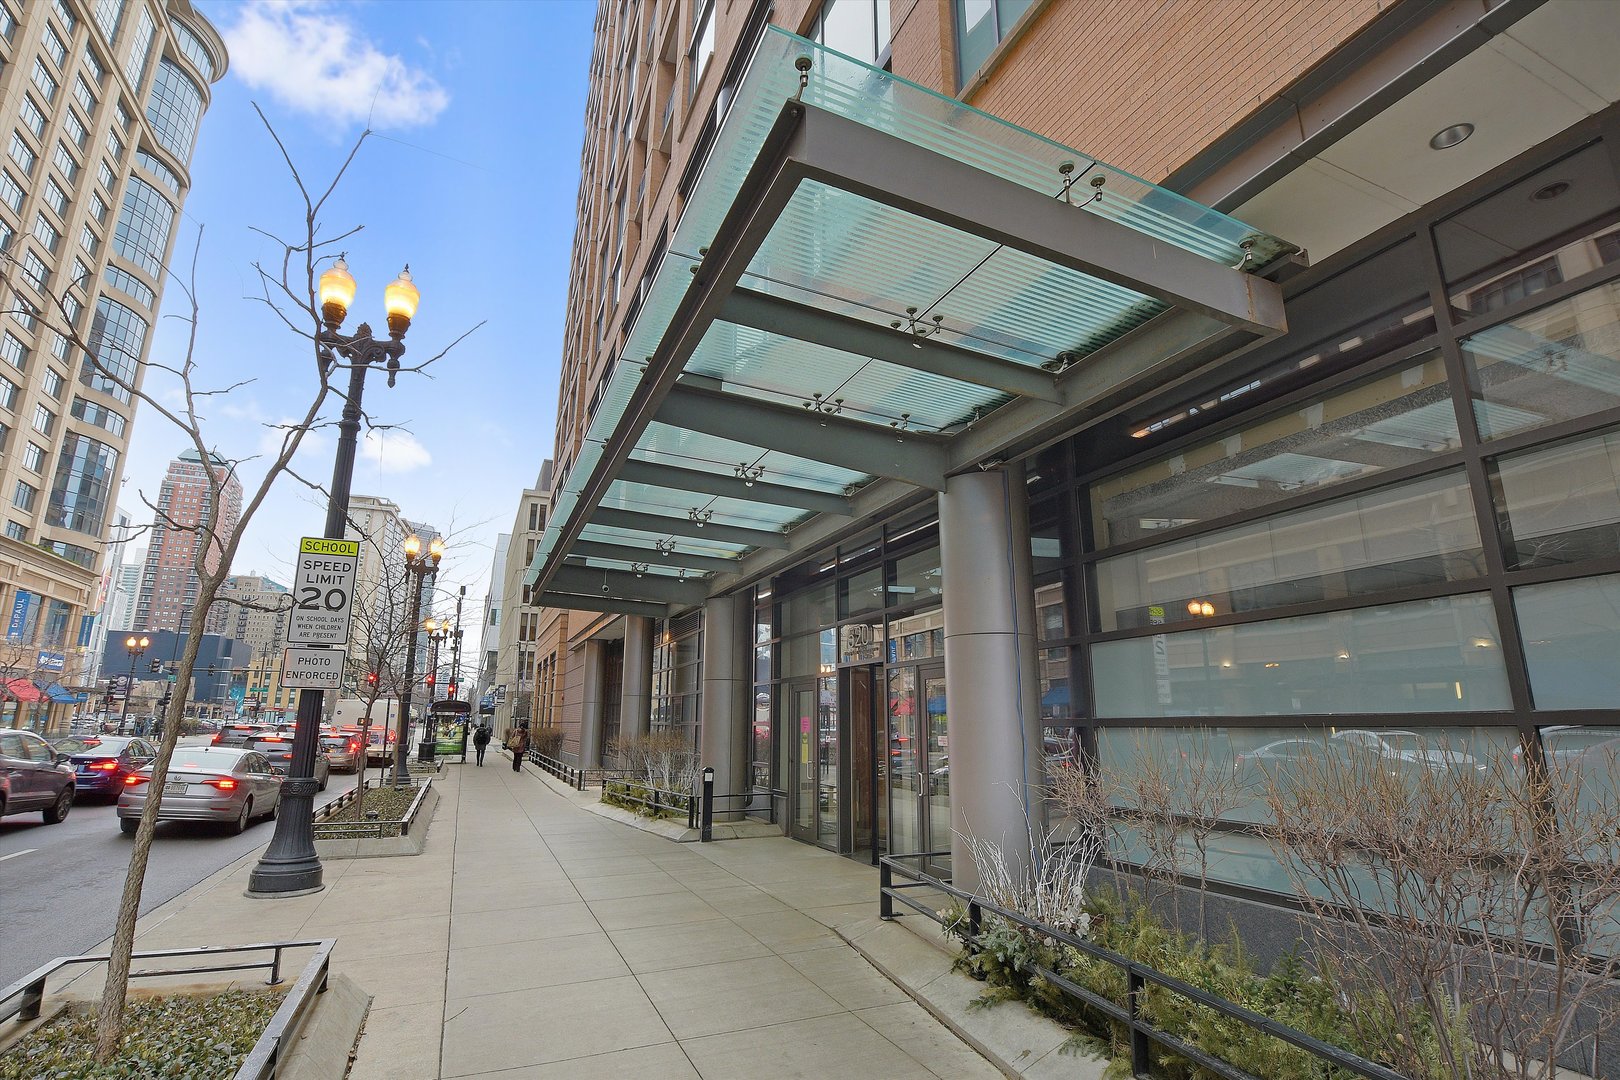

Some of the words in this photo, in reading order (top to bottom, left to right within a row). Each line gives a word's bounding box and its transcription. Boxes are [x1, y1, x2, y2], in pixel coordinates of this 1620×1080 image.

[305, 541, 354, 554] SCHOOL
[303, 560, 352, 573] SPEED
[306, 574, 345, 585] LIMIT
[298, 587, 347, 611] 20
[298, 657, 331, 666] PHOTO
[286, 671, 339, 680] ENFORCED
